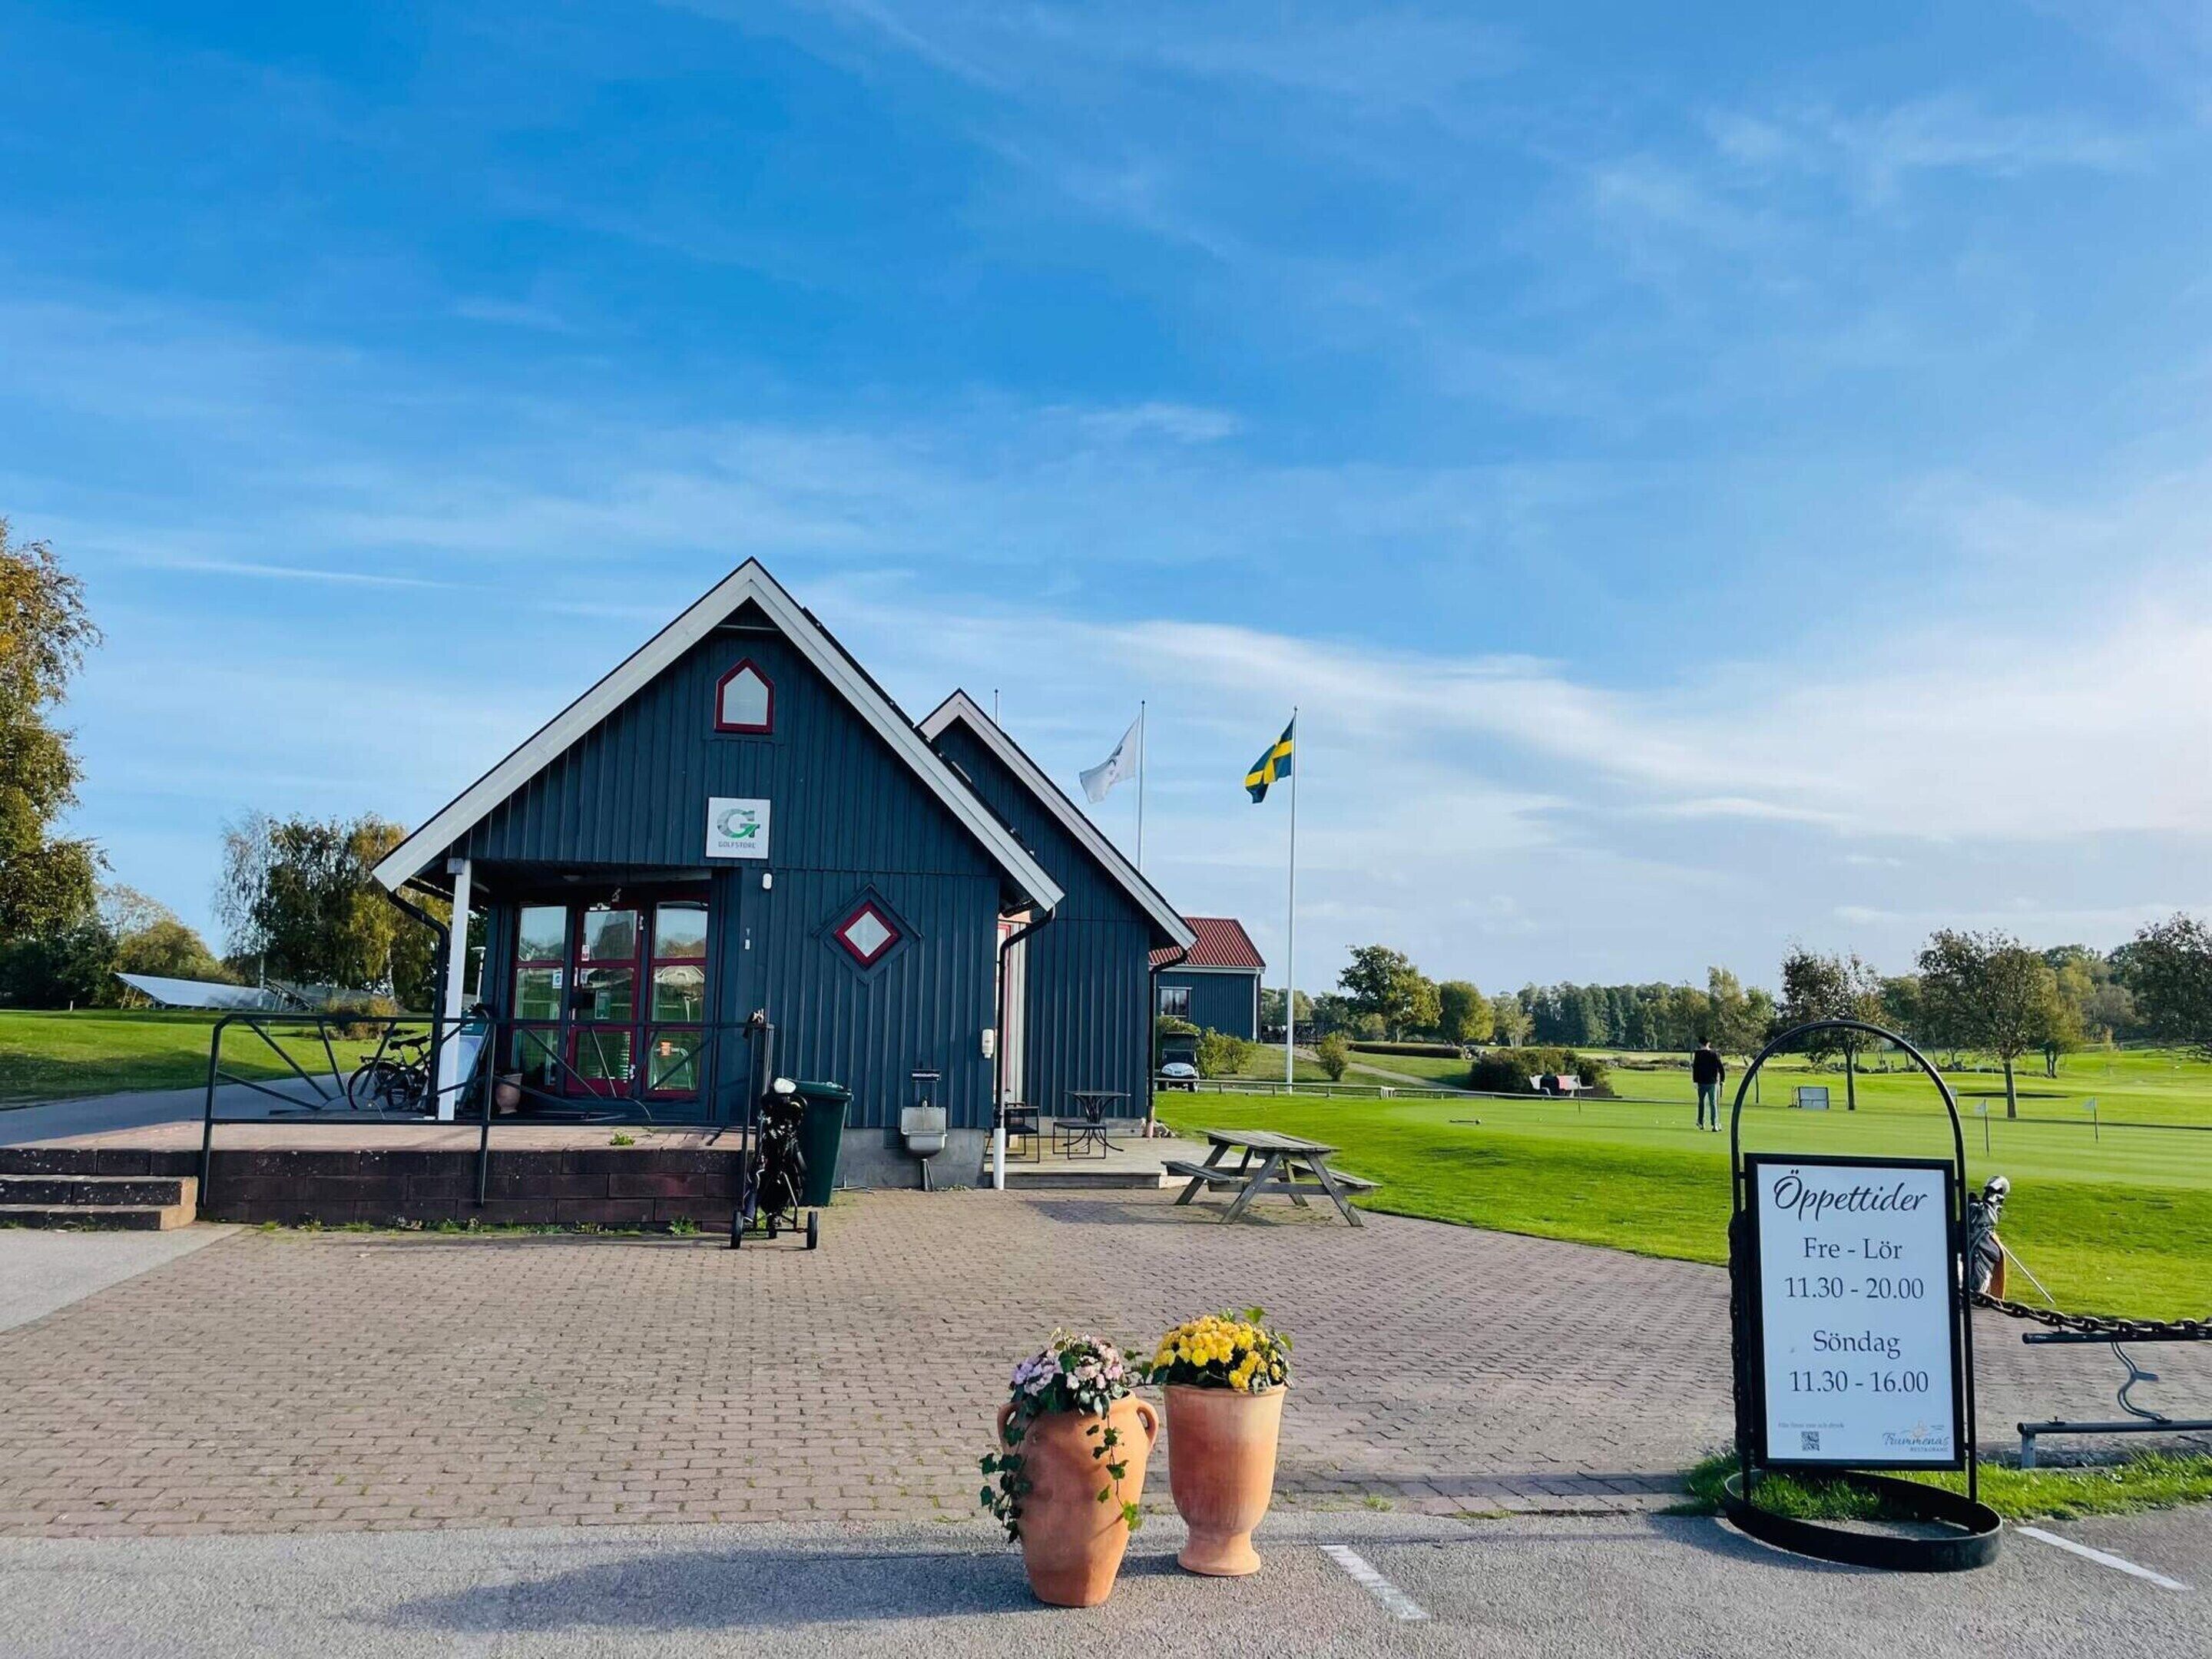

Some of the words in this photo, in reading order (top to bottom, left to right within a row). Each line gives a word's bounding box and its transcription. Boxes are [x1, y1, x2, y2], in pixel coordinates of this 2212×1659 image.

[1773, 1169, 1928, 1221] Öppettider
[1803, 1237, 1840, 1259] Fre
[1863, 1239, 1902, 1260] Lör
[1784, 1277, 1843, 1299] 11.30
[1866, 1278, 1924, 1300] 20.00
[1813, 1330, 1901, 1359] Söndag
[1790, 1370, 1848, 1392] 11.30
[1870, 1371, 1929, 1392] 16.00
